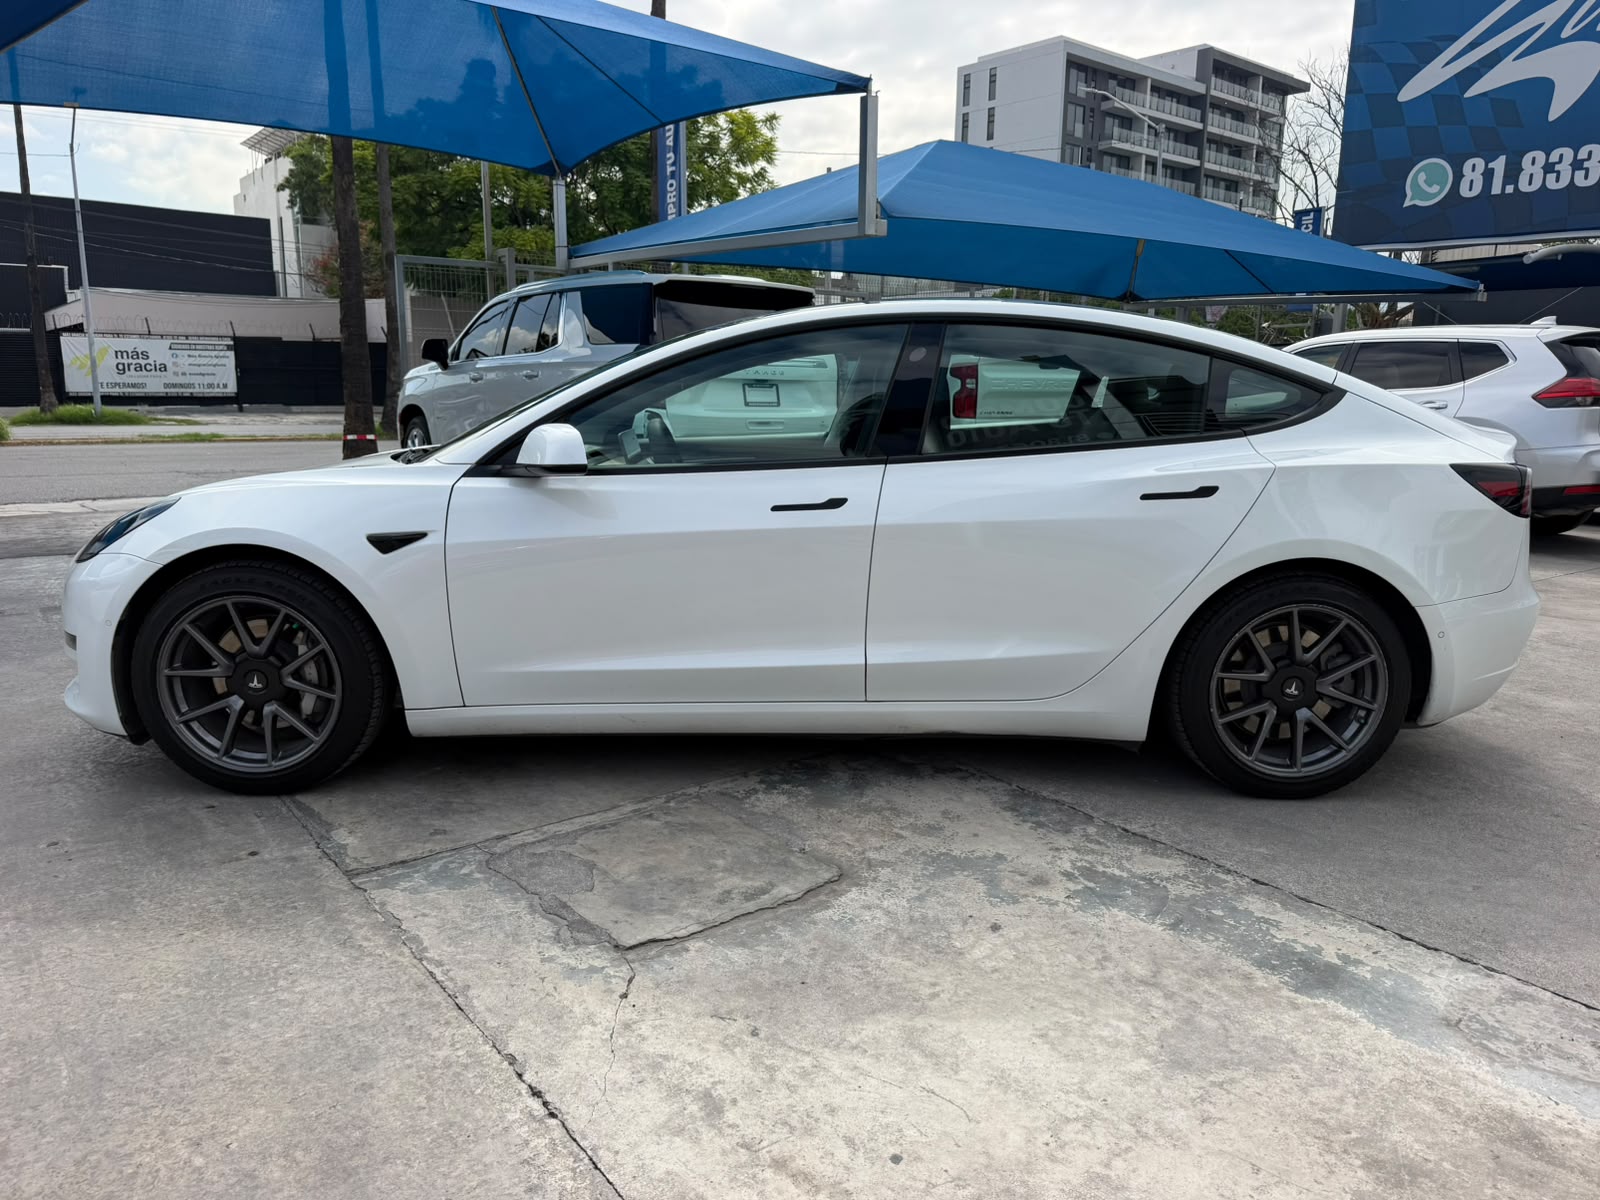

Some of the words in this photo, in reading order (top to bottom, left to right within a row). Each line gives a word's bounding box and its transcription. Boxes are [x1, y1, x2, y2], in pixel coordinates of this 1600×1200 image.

[666, 151, 676, 176] TU
[1459, 144, 1600, 198] 81.833
[666, 178, 677, 220] PRO
[1301, 211, 1315, 234] CIL
[115, 347, 150, 361] más
[115, 360, 168, 375] gracia
[163, 382, 196, 390] DOMINGOS
[197, 382, 215, 390] 11:00
